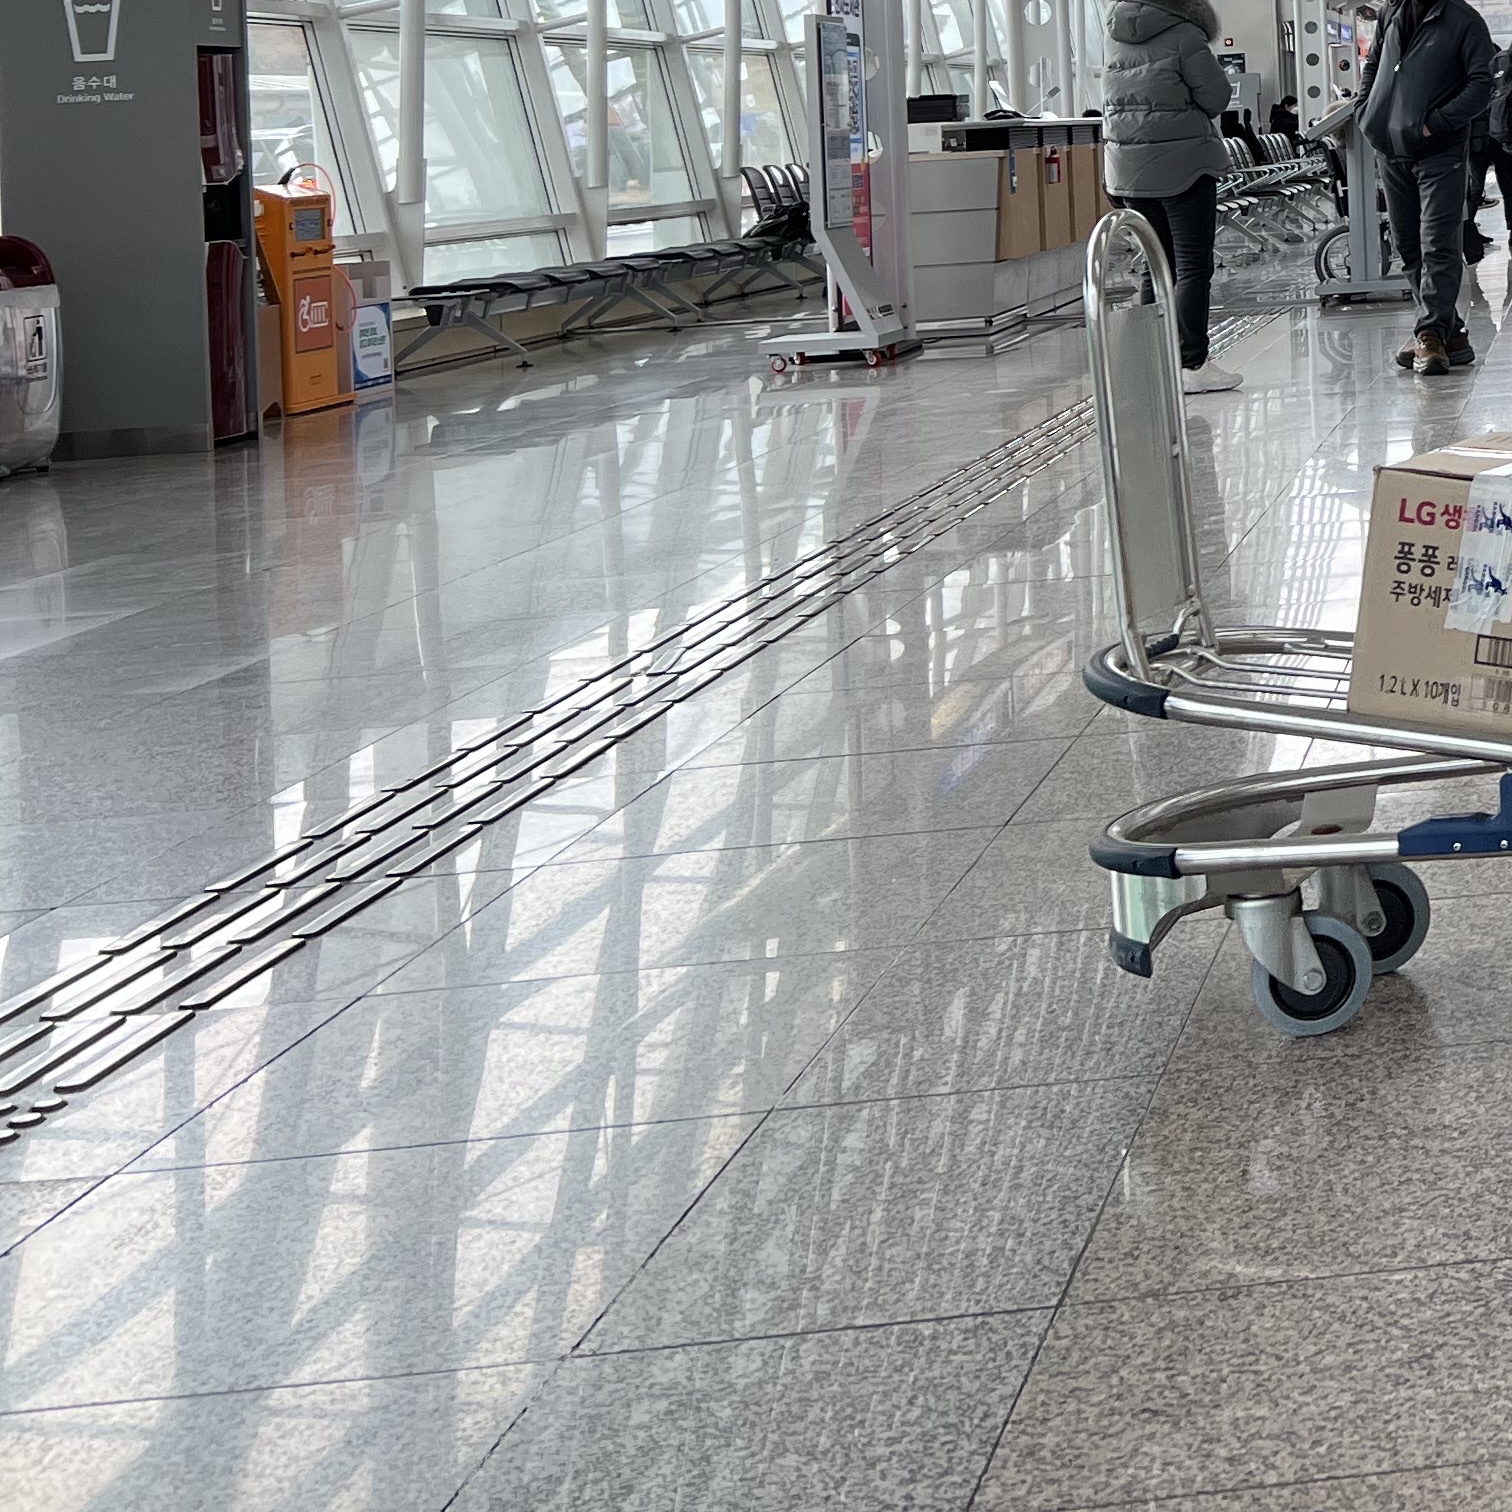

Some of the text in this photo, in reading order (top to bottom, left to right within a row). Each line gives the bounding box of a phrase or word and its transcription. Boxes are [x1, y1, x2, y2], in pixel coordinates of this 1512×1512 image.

[72, 75, 117, 91] 음수대
[57, 92, 134, 104] Drinking Water
[1394, 541, 1441, 578] 퐁퐁
